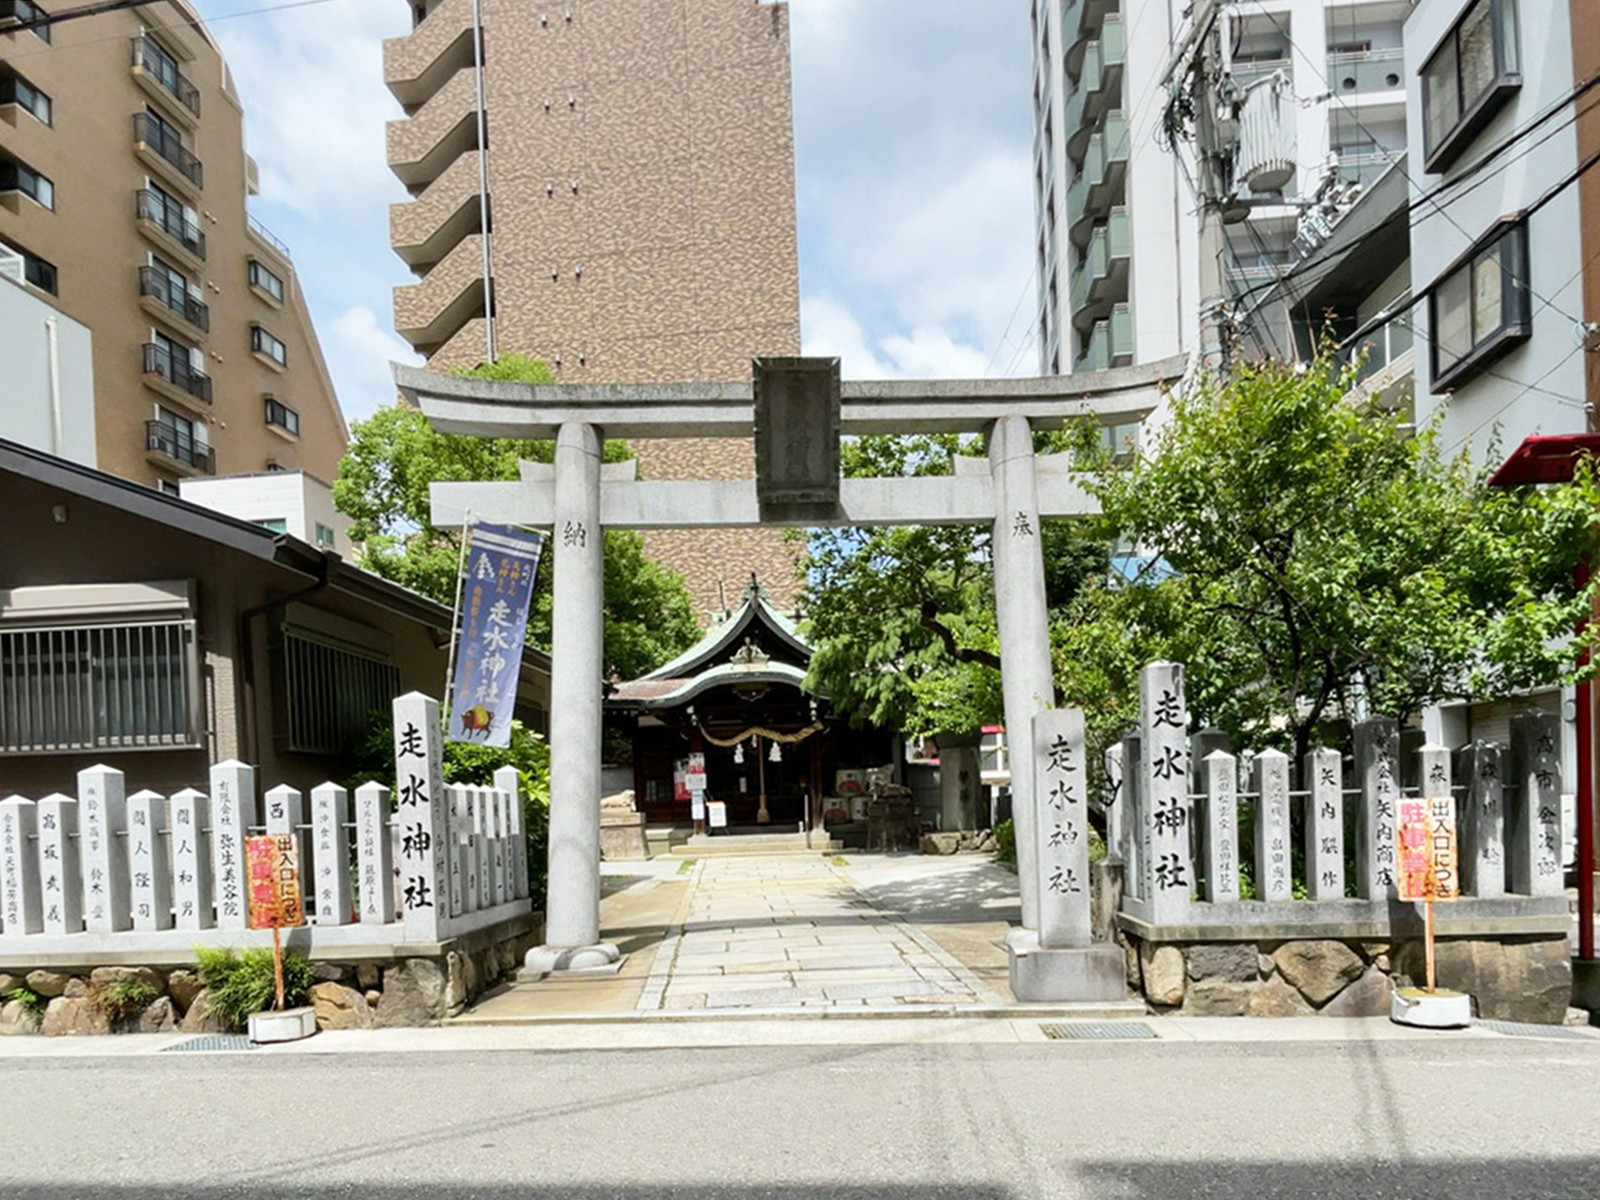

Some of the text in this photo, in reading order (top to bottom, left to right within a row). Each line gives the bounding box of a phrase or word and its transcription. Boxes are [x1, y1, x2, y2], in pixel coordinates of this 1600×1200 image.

[562, 520, 587, 549] 納
[1011, 510, 1034, 540] 奉
[476, 599, 512, 704] 走水神社
[398, 721, 435, 911] 走水神社
[1045, 733, 1081, 895] 走水神社
[1152, 689, 1188, 892] 走水神社
[249, 839, 275, 928] 駐車禁止
[277, 835, 297, 924] 出入口につき
[1401, 802, 1427, 898] 駐車禁止
[1432, 800, 1452, 899] 出入口につき
